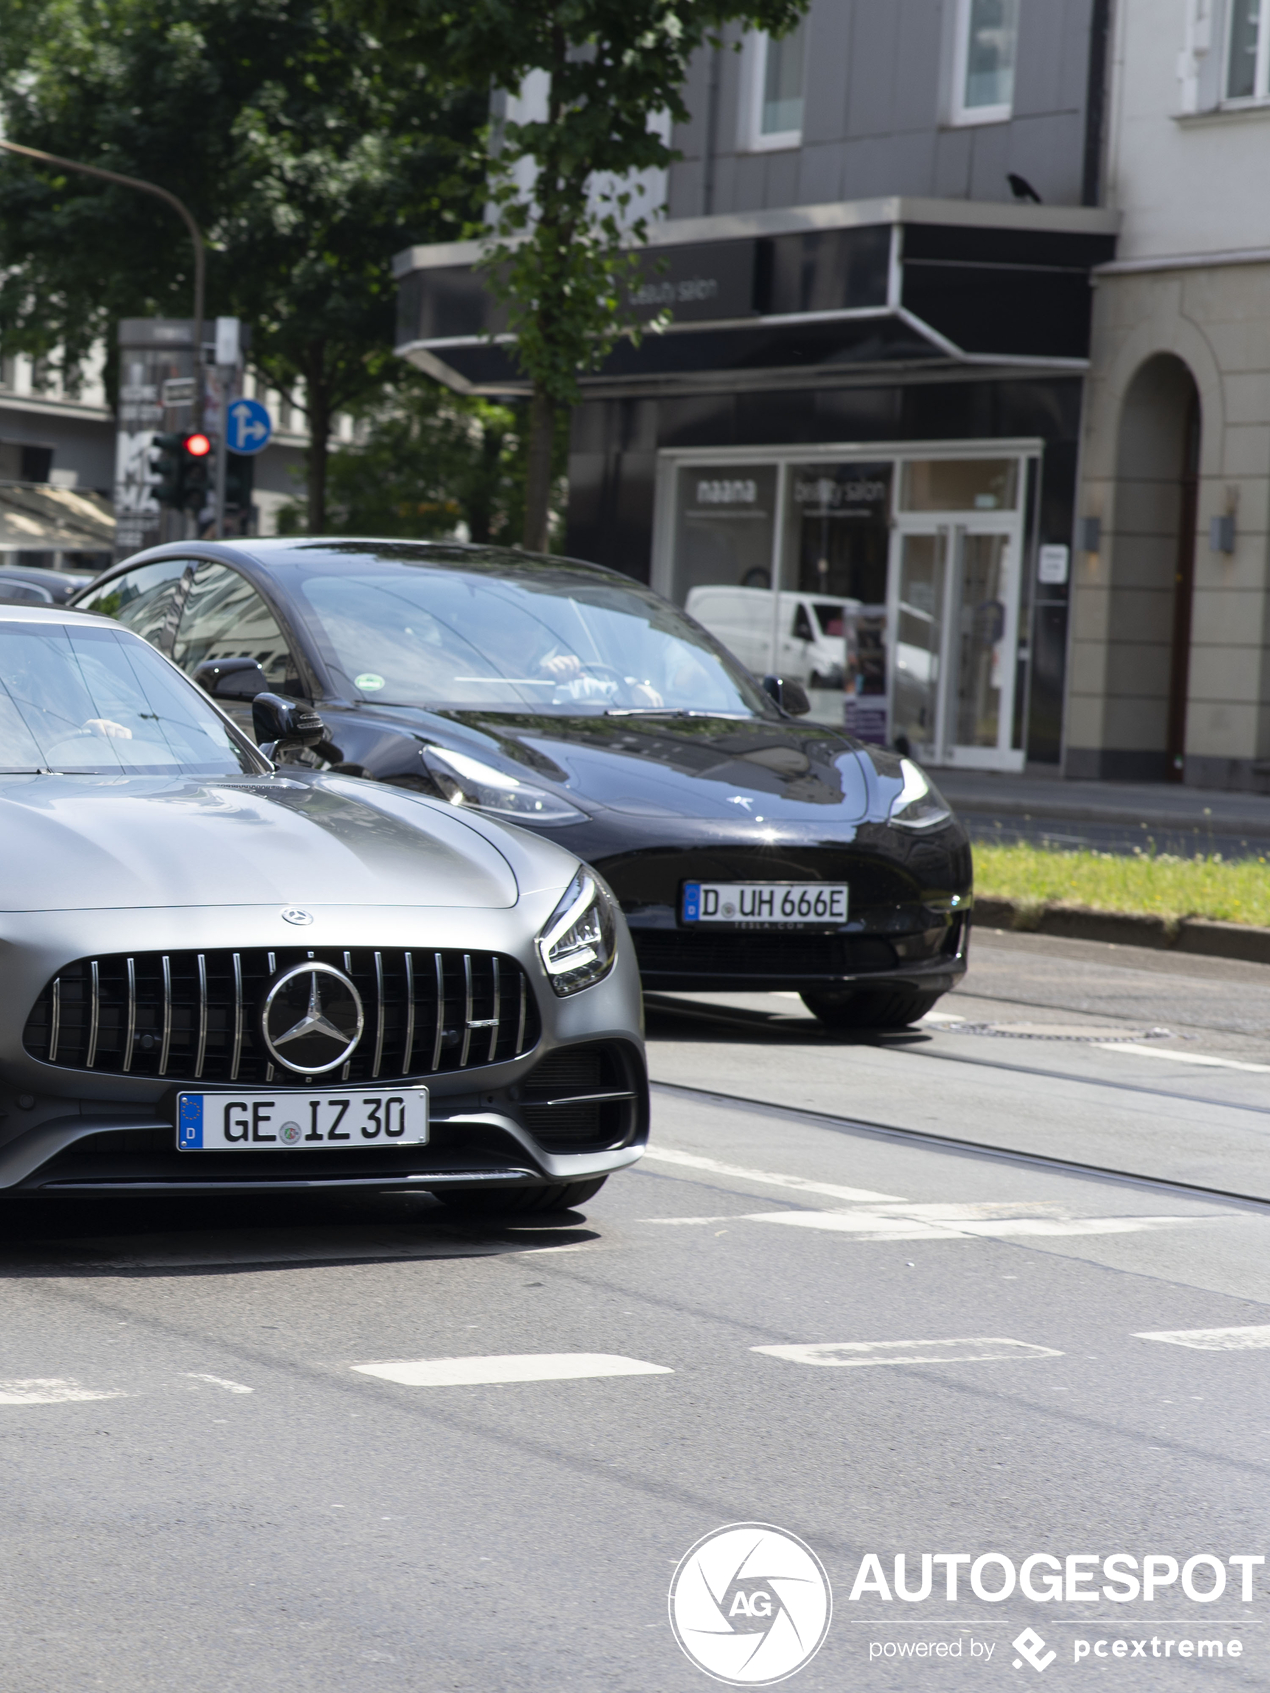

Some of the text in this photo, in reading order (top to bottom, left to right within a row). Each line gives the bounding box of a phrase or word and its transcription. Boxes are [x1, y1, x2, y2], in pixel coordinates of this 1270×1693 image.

[688, 905, 696, 915] D
[702, 889, 844, 917] D UH 666E
[224, 1096, 405, 1142] GE IZ 30
[186, 1128, 196, 1140] D
